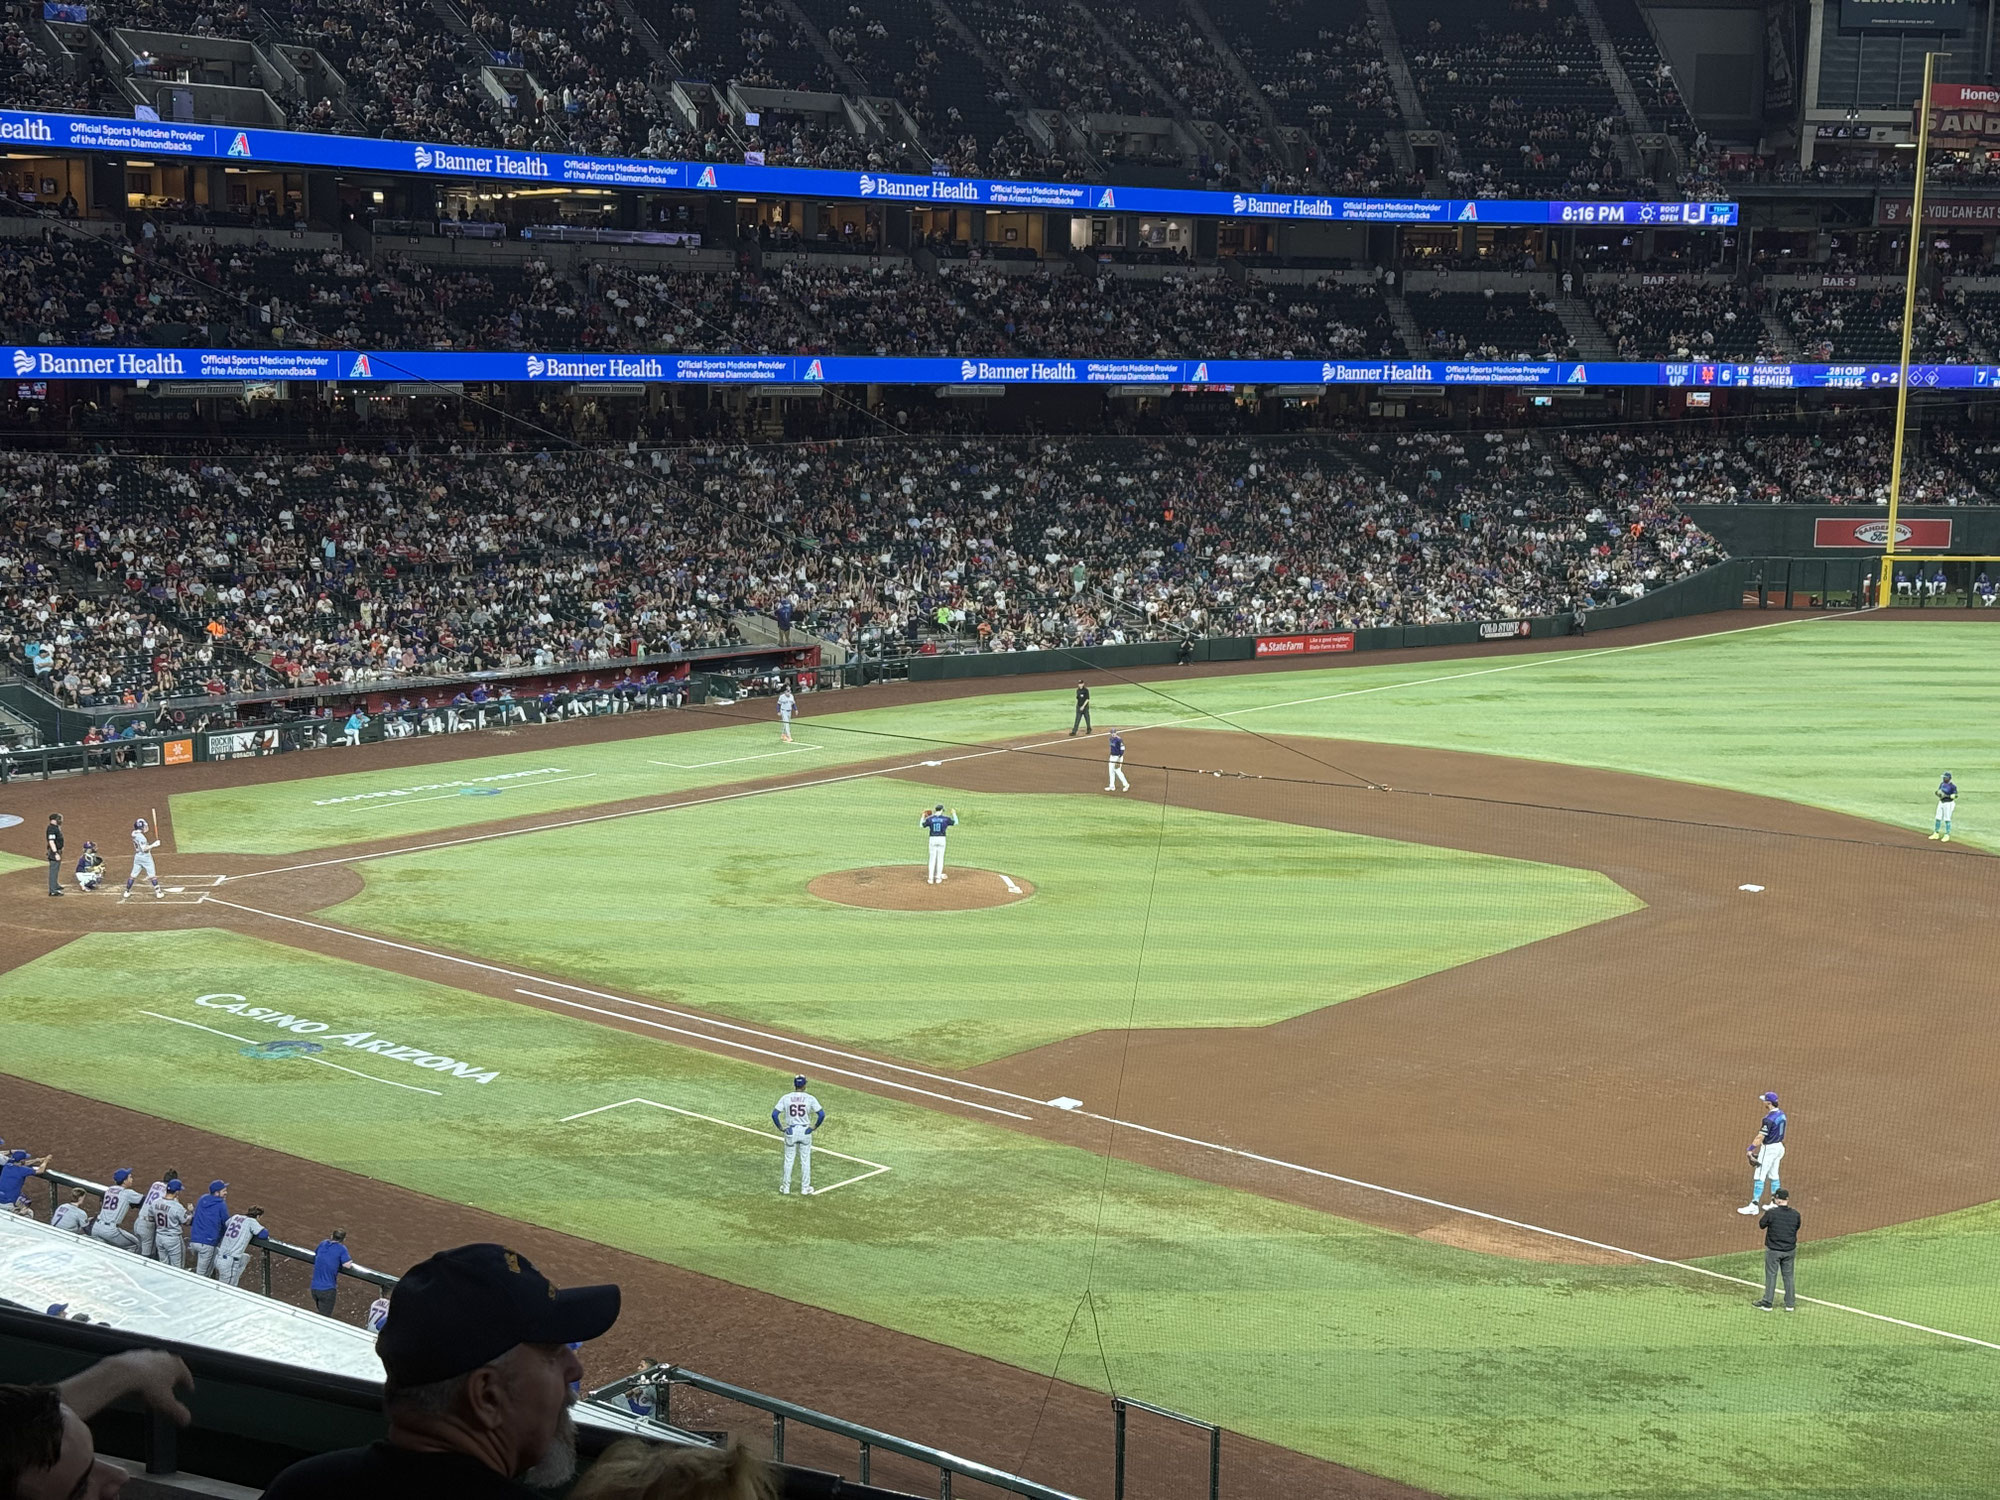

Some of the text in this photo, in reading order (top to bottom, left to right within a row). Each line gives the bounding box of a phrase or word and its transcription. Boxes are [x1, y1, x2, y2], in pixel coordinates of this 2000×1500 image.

[1960, 88, 2000, 103] Honey
[0, 118, 51, 141] ealth
[70, 123, 205, 142] Official Sports Medicine Provider
[70, 135, 192, 152] of the Arizona Diamondbacks
[434, 150, 548, 176] Banner Health
[564, 160, 678, 176] Official Sports Medicine Provider
[564, 170, 667, 184] of the Arizona Diamondbacks
[877, 178, 978, 200] Banner Health
[990, 184, 1084, 198] Official Sports Medicine Provider
[990, 194, 1074, 205] of the Arizona Diamondbacks
[1248, 198, 1332, 216] Banner Health
[1343, 202, 1362, 210] Official
[1363, 203, 1384, 212] Sports
[1385, 204, 1414, 212] Medicine
[1562, 206, 1624, 221] 8:16 PM
[1343, 210, 1350, 218] of
[1359, 212, 1382, 220] Arizona
[1383, 212, 1430, 220] Diamondbacks
[1712, 214, 1730, 224] 94F
[1822, 277, 1856, 286] BAR-S
[40, 353, 184, 374] Banner Health
[201, 355, 328, 368] Official Sports Medicine Provider
[677, 360, 786, 372] Official Sports Medicine Provider
[201, 366, 317, 378] of the Arizona Diamondbacks
[547, 359, 662, 378] Banner Health
[677, 370, 776, 380] of the Arizona Diamondbacks
[979, 364, 1076, 380] Banner Health
[1109, 365, 1128, 374] Sports
[1155, 365, 1178, 373] Provider
[1336, 365, 1432, 380] Banner Health
[1470, 366, 1492, 375] Sports
[1666, 366, 1688, 376] DUE
[1738, 366, 1748, 376] 10
[1753, 366, 1790, 374] MARCUS
[1846, 367, 1866, 376] OBP
[1088, 373, 1169, 382] of the Arizona Diamondbacks
[1446, 374, 1539, 383] of the Arizona Diamondbacks
[1669, 376, 1685, 386] UP
[1722, 370, 1730, 381] 6
[1752, 376, 1794, 386] SEMIEN
[1845, 378, 1863, 386] SLG
[1978, 372, 1986, 383] 7
[1480, 622, 1520, 636] COLD STONE
[195, 993, 500, 1084] CASINO ARIZONA
[790, 1104, 806, 1117] 65
[103, 1196, 119, 1210] 28
[54, 1214, 64, 1226] 7
[156, 1213, 168, 1227] 61
[226, 1222, 242, 1238] 26
[370, 1308, 386, 1325] 77
